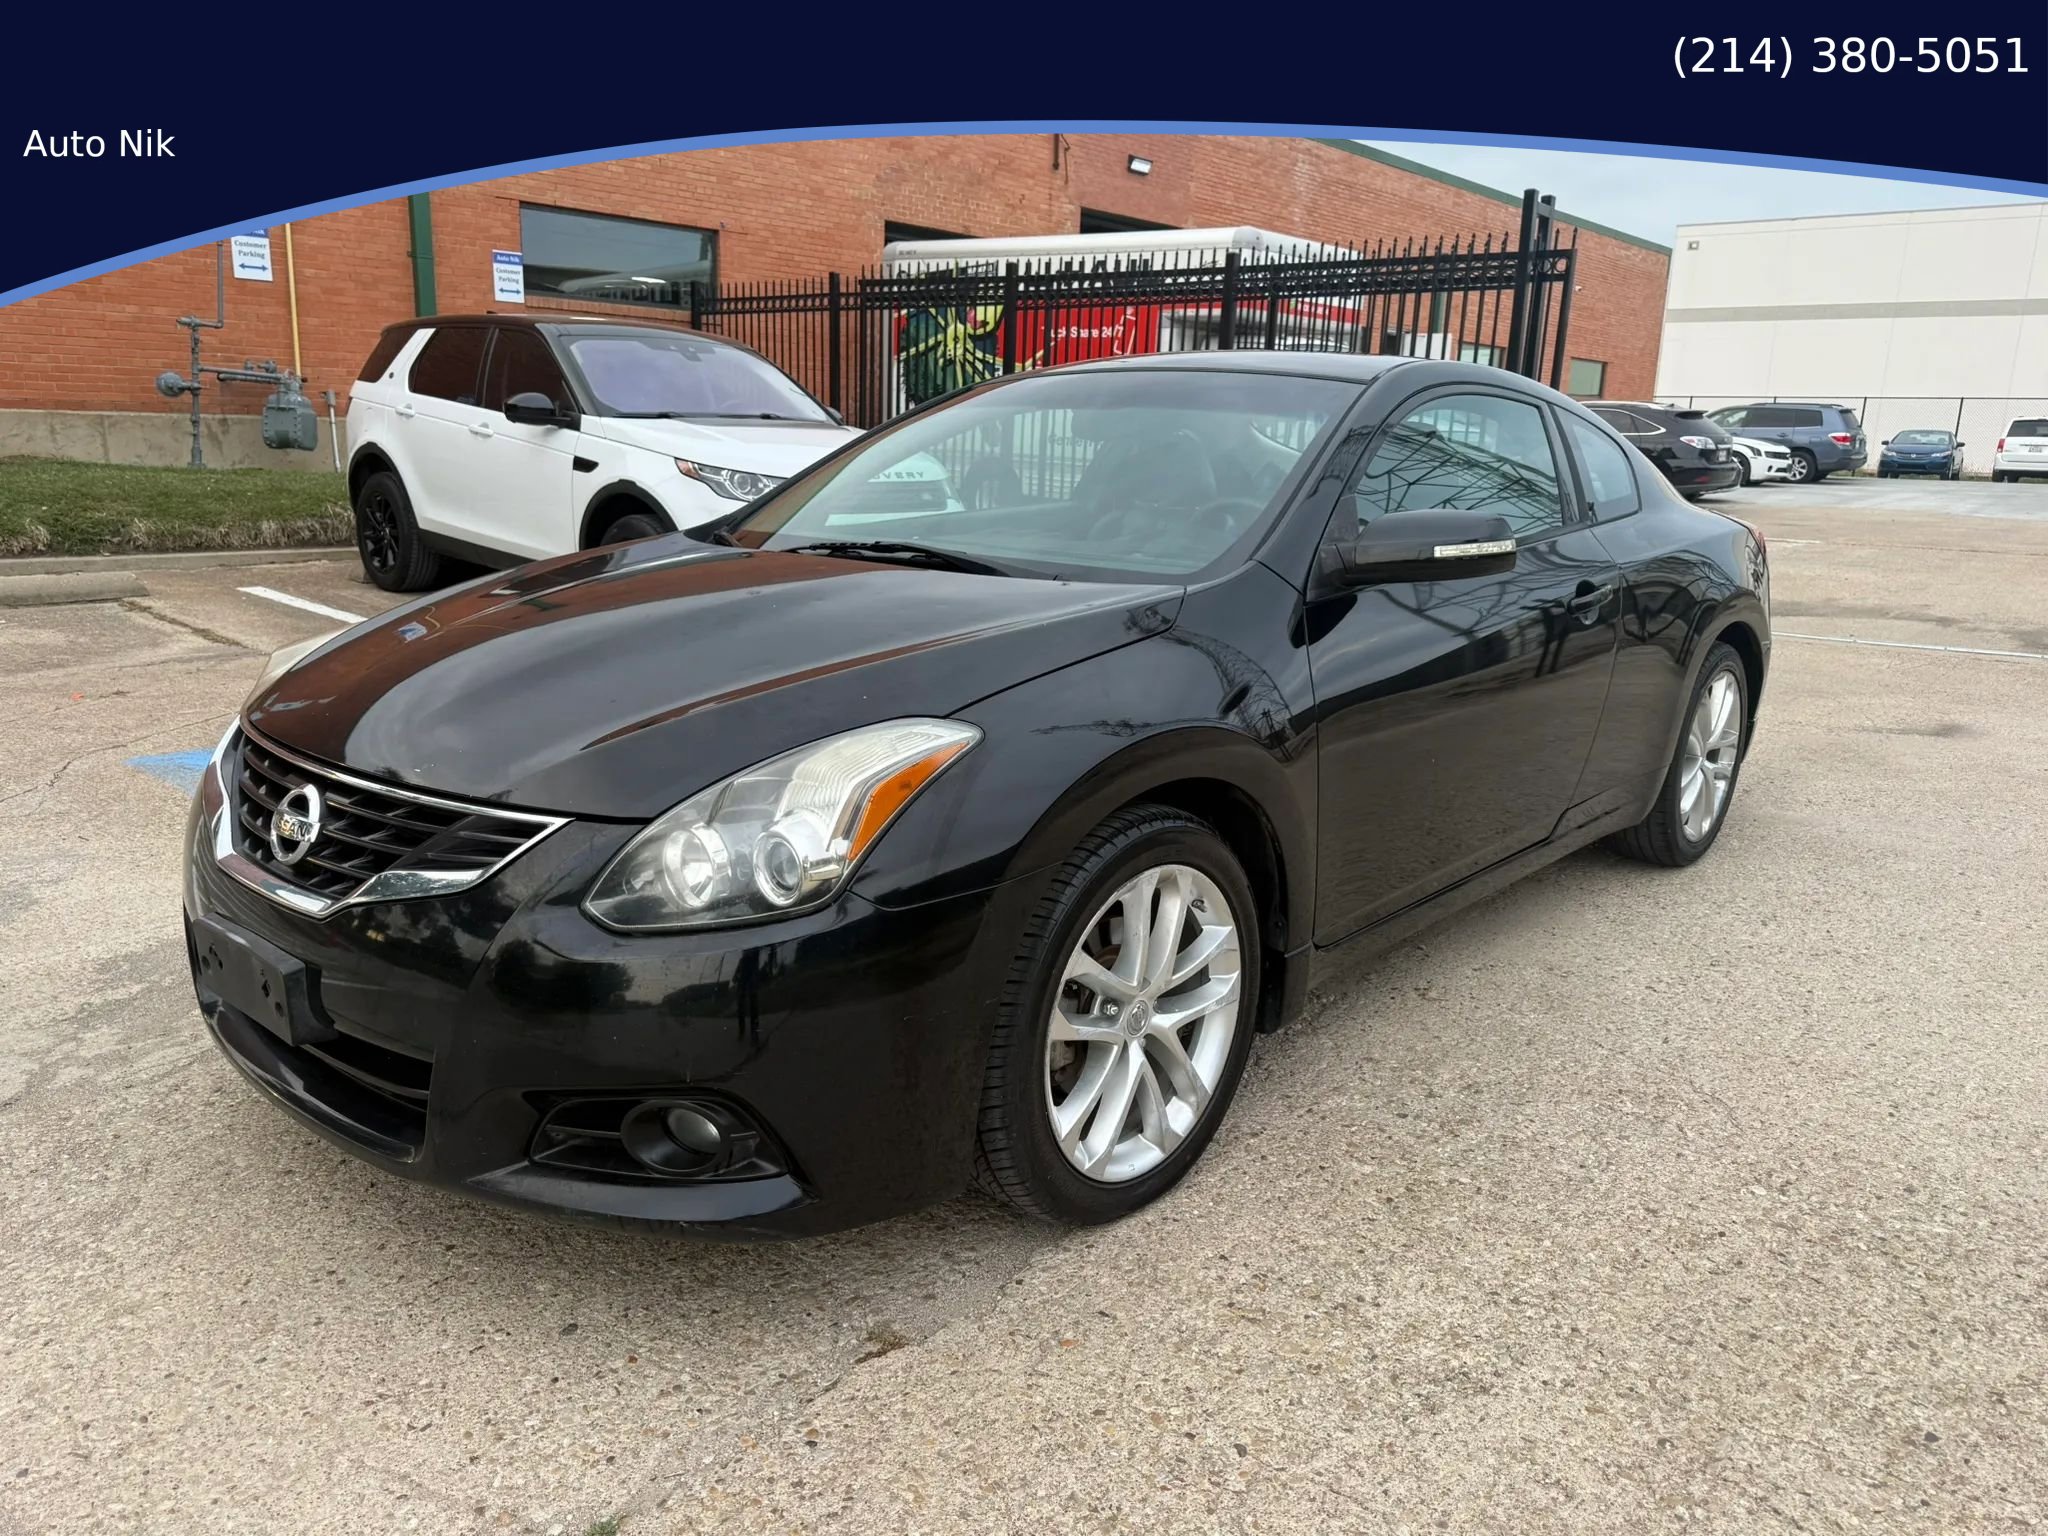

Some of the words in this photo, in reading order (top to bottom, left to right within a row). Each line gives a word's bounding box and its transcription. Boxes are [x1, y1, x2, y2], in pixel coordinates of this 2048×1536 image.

[234, 240, 266, 249] Customer
[238, 250, 265, 260] Parking
[496, 254, 510, 262] Auto
[498, 276, 520, 285] Parking
